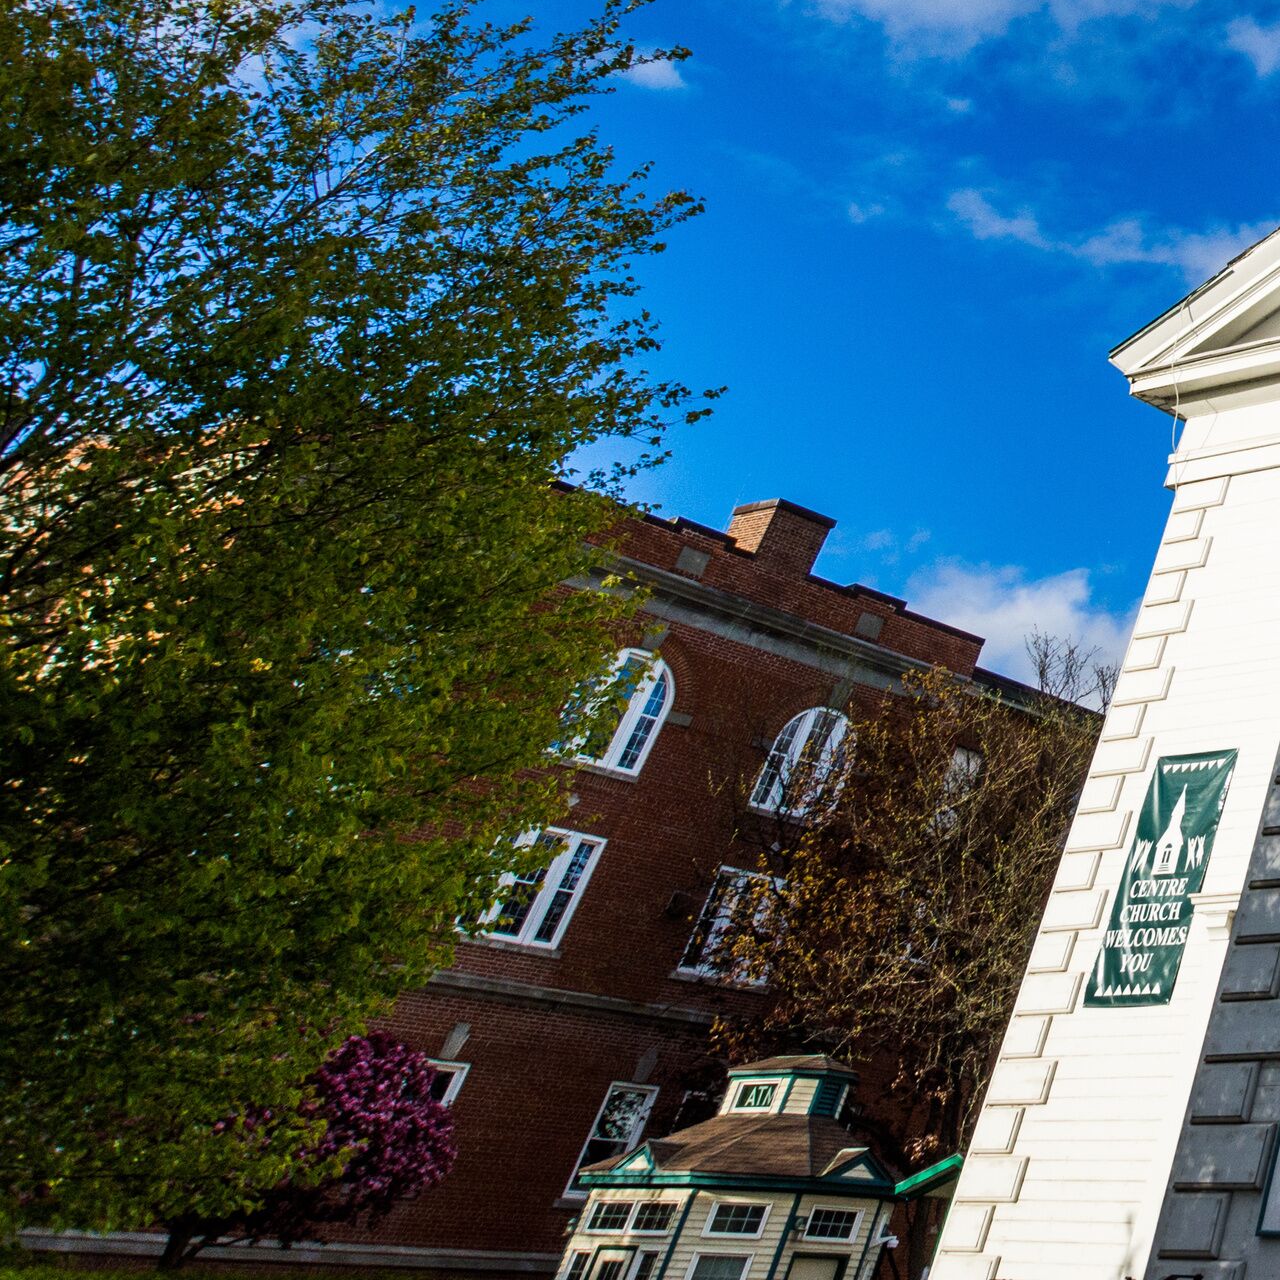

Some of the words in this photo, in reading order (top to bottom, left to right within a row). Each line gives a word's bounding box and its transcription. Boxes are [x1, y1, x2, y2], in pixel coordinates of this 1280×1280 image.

[1130, 878, 1188, 898] CENTRE
[1119, 901, 1182, 923] CHURCH
[1105, 926, 1188, 948] WELCOMES
[1119, 952, 1154, 974] YOU
